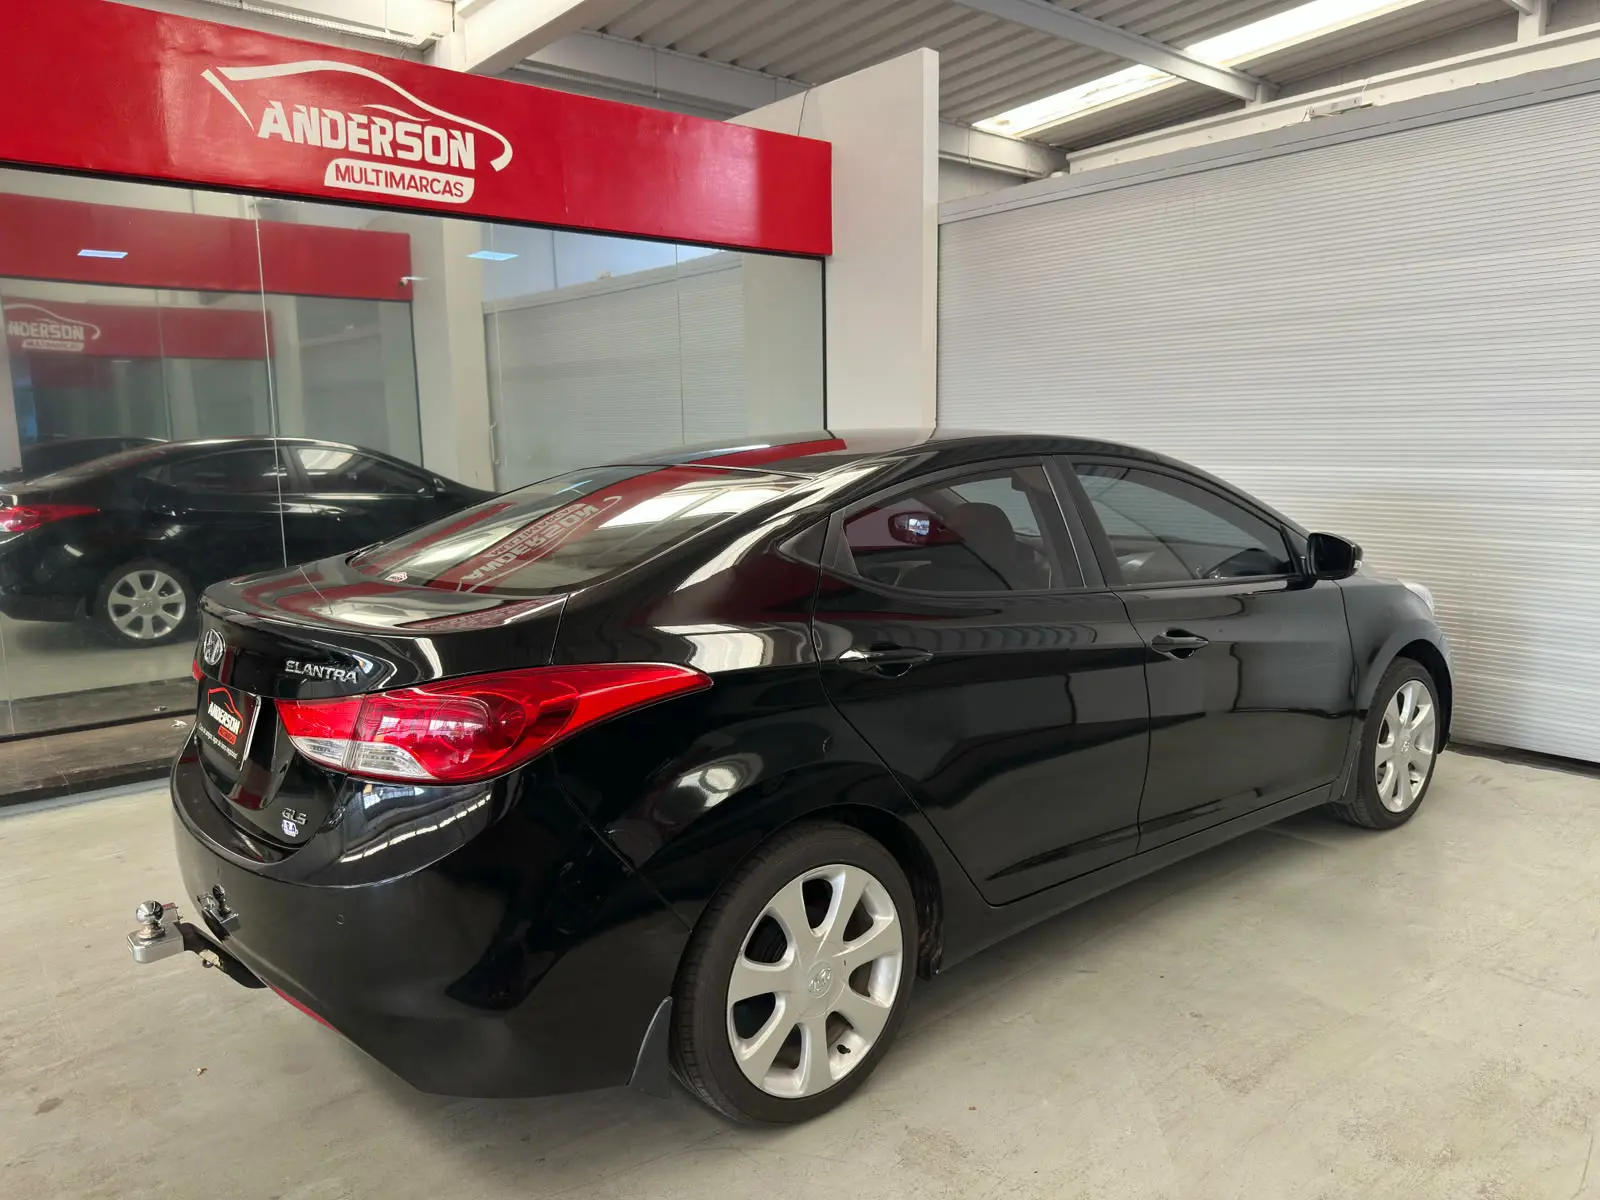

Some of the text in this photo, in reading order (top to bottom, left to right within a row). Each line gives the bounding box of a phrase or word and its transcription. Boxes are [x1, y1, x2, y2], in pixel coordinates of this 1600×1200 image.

[257, 99, 476, 170] ANDERSON
[334, 163, 465, 198] MULTIMARCAS
[7, 320, 85, 341] NDERSON
[284, 660, 358, 684] ELANTRA
[281, 807, 307, 825] GLS
